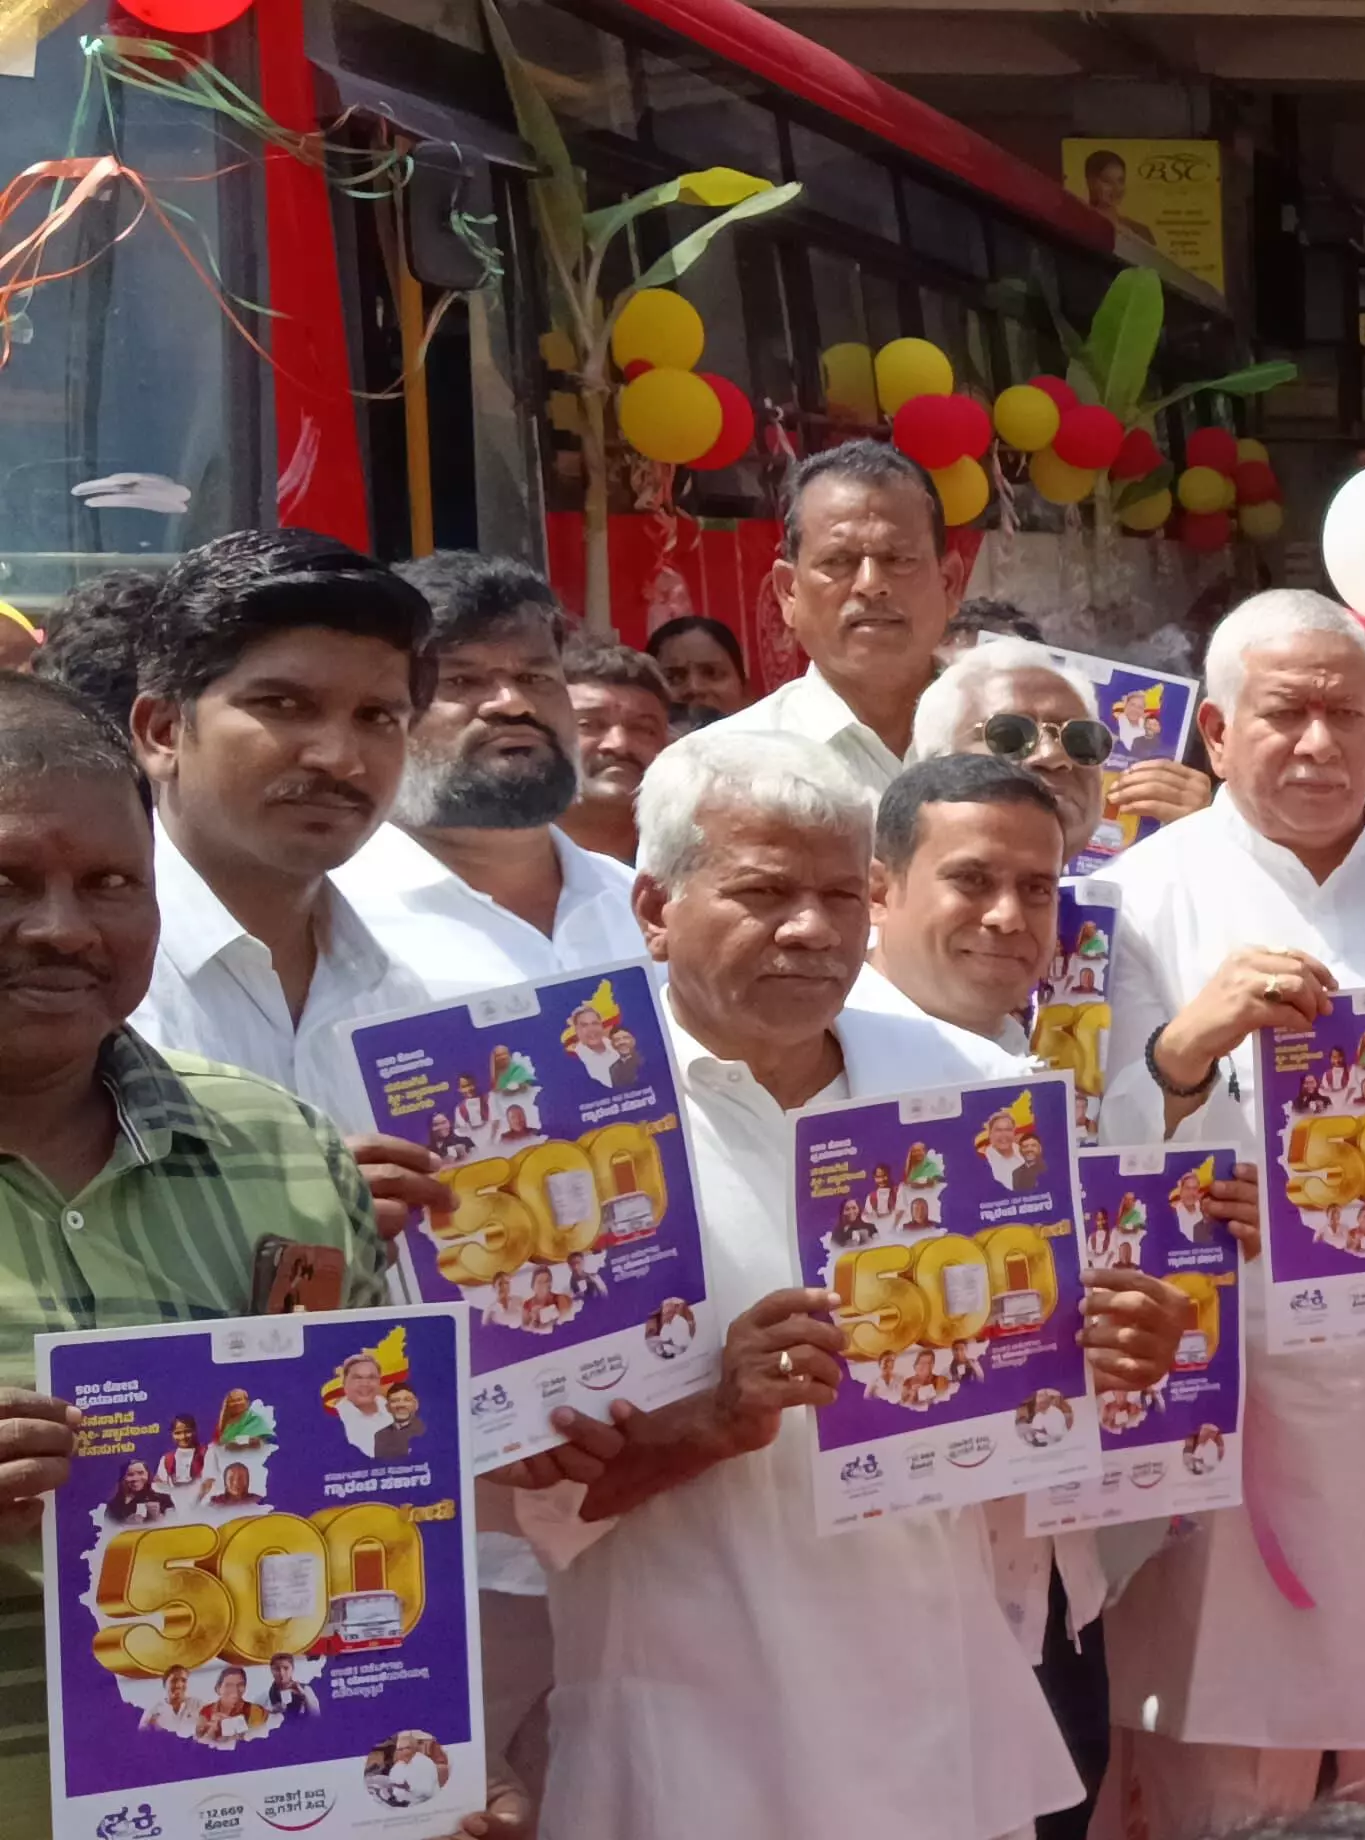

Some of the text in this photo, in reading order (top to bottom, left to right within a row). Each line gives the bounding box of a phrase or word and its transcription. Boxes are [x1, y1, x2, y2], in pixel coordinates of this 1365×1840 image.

[425, 1123, 668, 1286] 500
[831, 1224, 1059, 1362] 500
[93, 1502, 425, 1677] 500
